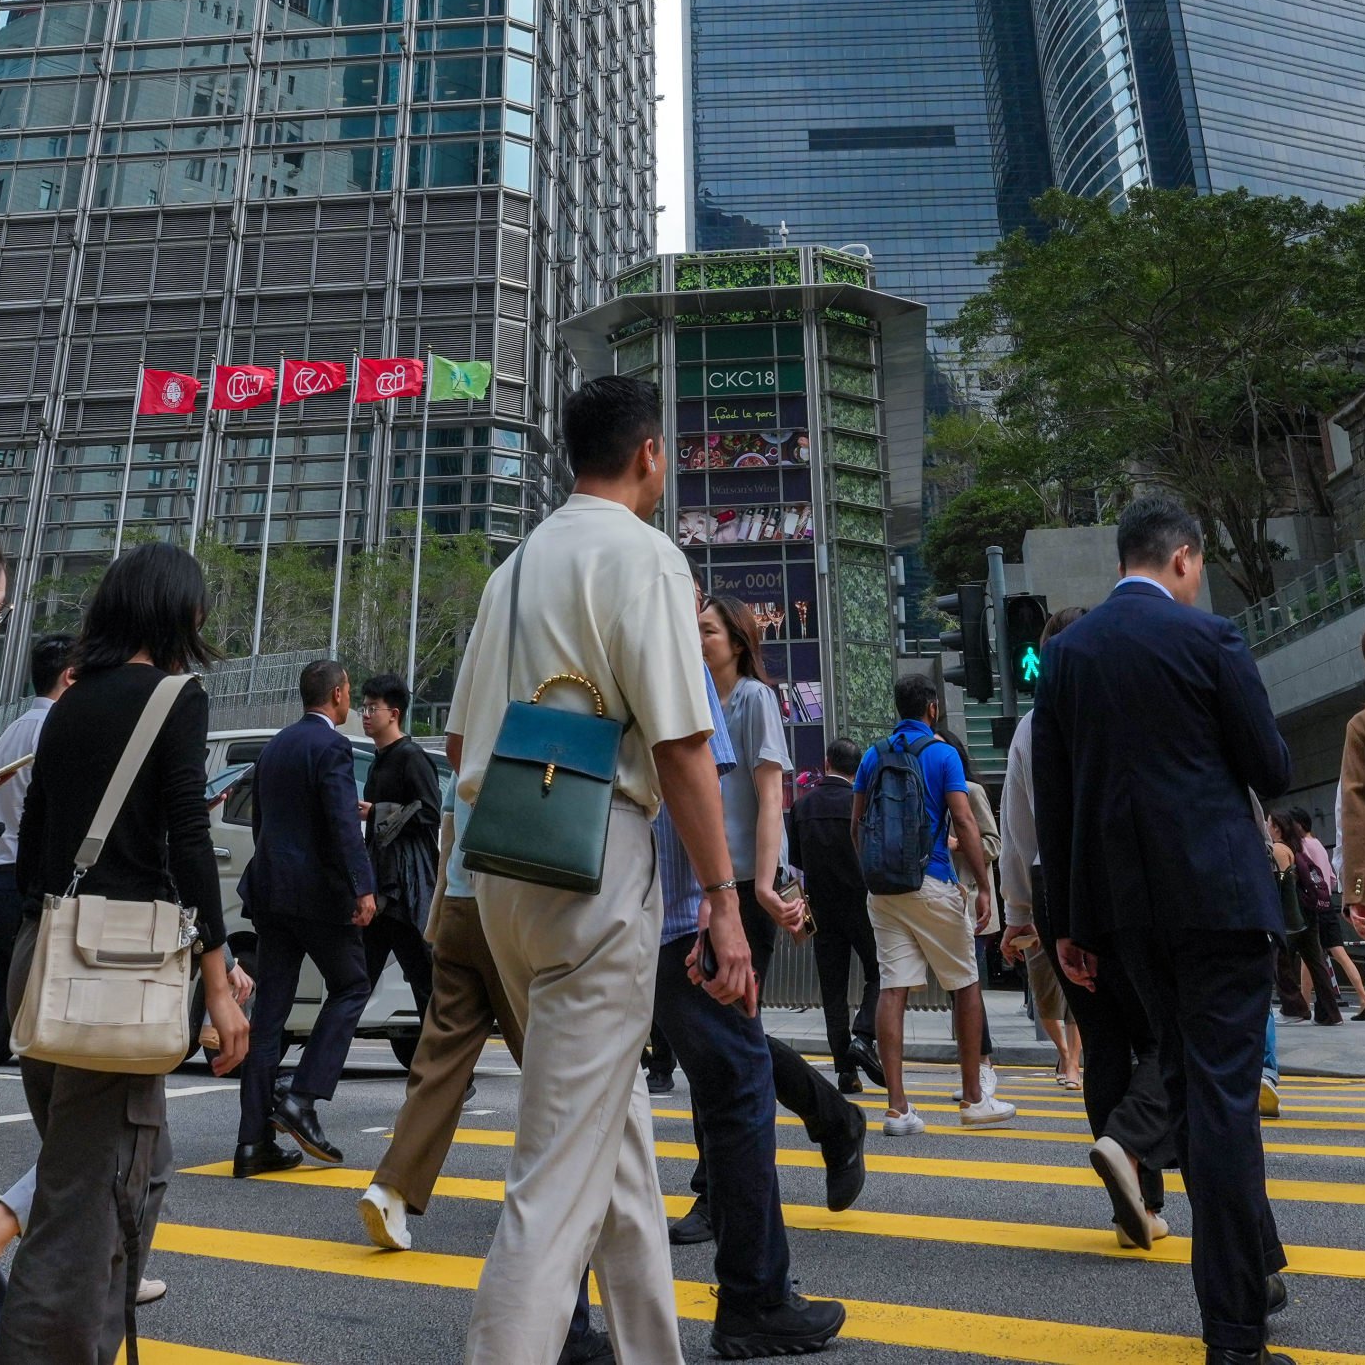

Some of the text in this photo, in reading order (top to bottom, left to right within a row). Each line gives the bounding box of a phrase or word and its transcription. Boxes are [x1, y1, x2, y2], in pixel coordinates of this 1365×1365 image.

[708, 370, 775, 388] CKC18
[708, 406, 778, 424] food le parc
[711, 483, 779, 494] Watson's Wine
[713, 571, 783, 589] Bar 0001
